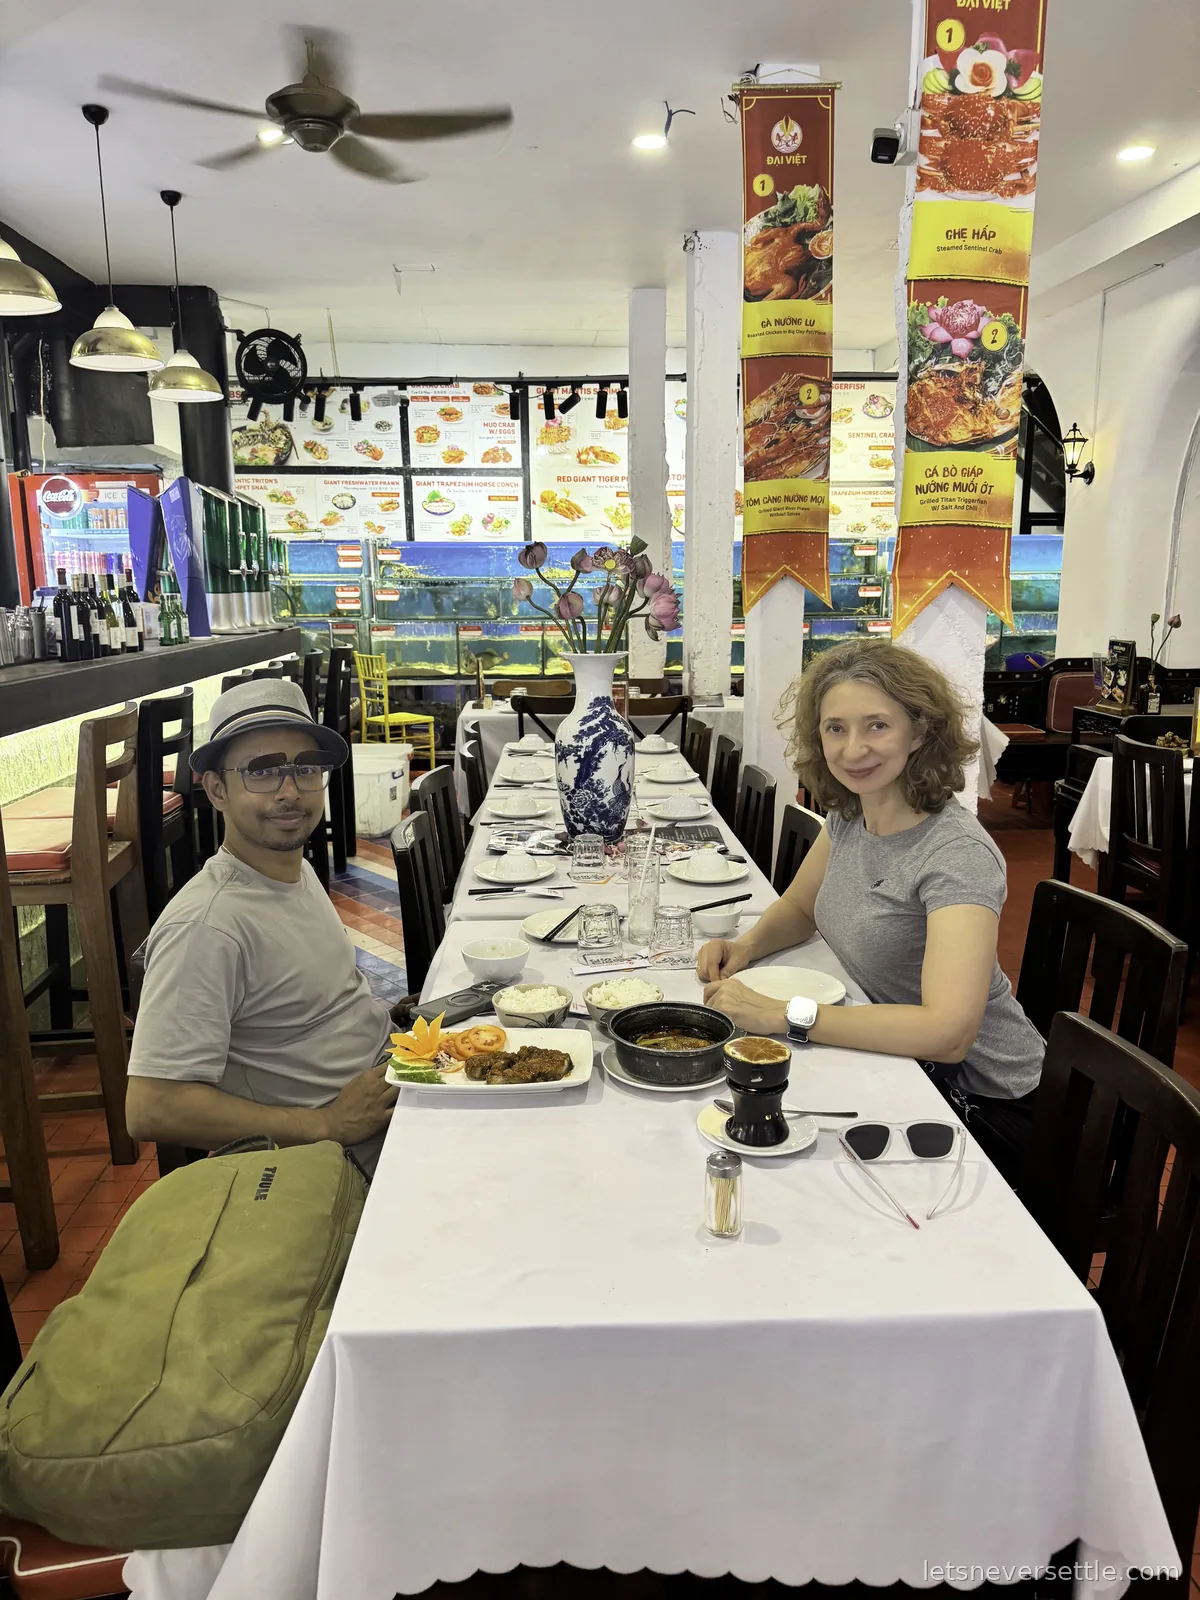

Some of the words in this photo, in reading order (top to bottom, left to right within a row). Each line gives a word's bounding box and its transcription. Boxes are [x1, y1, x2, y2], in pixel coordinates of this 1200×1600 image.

[946, 28, 953, 43] 1
[766, 156, 783, 166] ĐẠI
[786, 153, 807, 166] VIỆT
[760, 180, 765, 191] 1
[972, 225, 996, 241] HẤP
[989, 247, 1002, 255] Crab
[761, 318, 772, 328] GÀ
[805, 319, 815, 327] LU
[991, 329, 998, 344] 2
[806, 389, 812, 399] 2
[925, 466, 939, 478] CÁ
[942, 465, 957, 478] BÒ
[557, 475, 572, 483] RED
[573, 475, 596, 483] GIANT
[598, 475, 619, 483] TIGER
[915, 480, 950, 495] NƯỚNG
[920, 497, 939, 505] Grilled
[957, 497, 987, 505] Triggerfish
[254, 1167, 277, 1200] THULE
